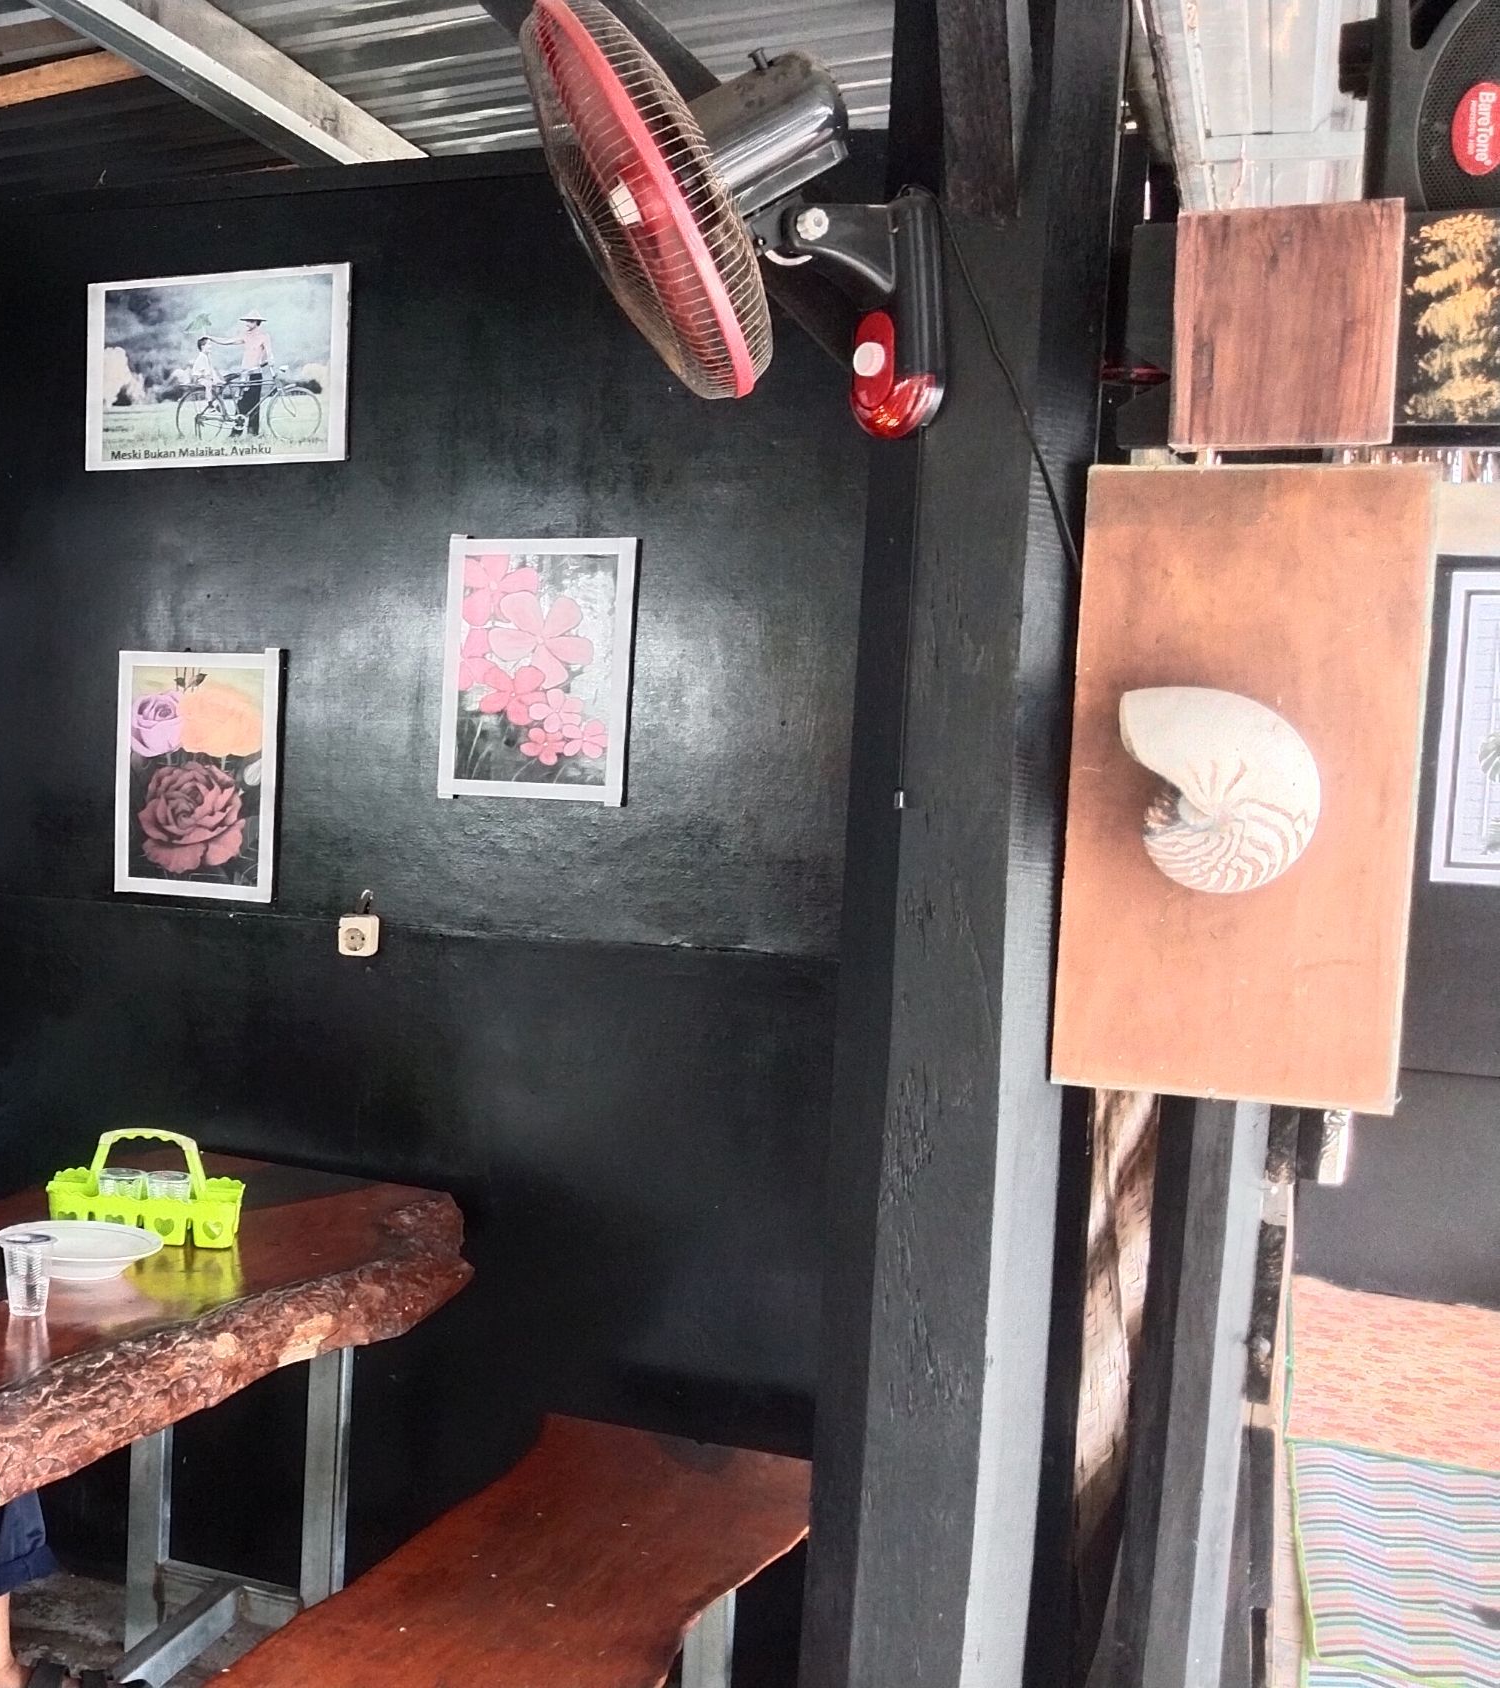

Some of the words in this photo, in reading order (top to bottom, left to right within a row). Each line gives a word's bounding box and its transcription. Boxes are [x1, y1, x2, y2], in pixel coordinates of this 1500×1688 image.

[111, 449, 142, 460] Meski
[144, 448, 176, 459] Bukan
[230, 444, 272, 456] Ayahku
